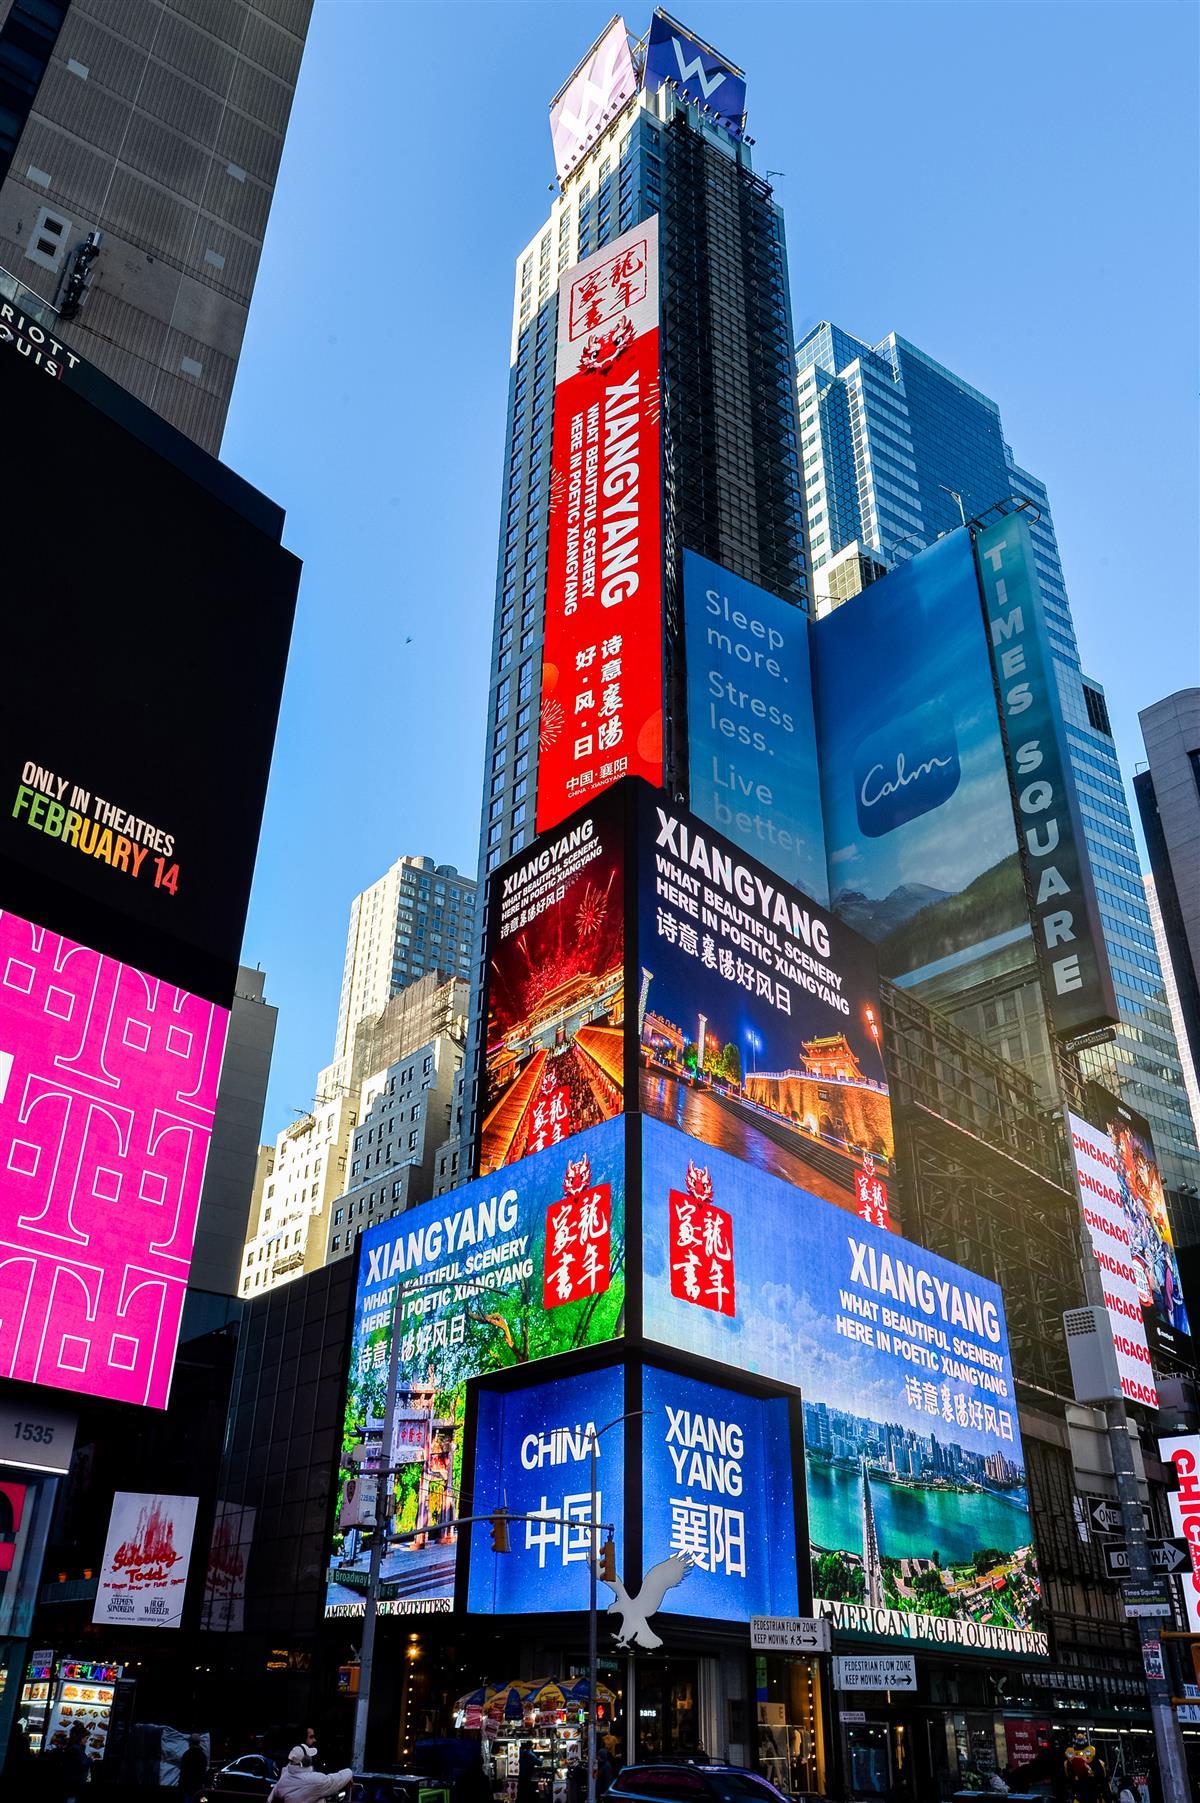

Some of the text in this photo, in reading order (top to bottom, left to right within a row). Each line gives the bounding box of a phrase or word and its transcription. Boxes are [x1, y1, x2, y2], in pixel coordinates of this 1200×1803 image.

[671, 37, 727, 100] W
[1, 304, 80, 368] RIOTT
[564, 411, 583, 616] HERE IN POETIC XIANGYANG
[581, 402, 600, 599] WHAT BEAUTIFUL SCENERY
[600, 369, 640, 608] XIANGYANG
[705, 590, 784, 650] Sleep
[707, 626, 789, 683] more.
[708, 671, 794, 733] Stress
[711, 703, 774, 756] less.
[567, 787, 587, 798] CHINA
[712, 756, 773, 806] Live
[861, 753, 952, 807] Calm
[984, 540, 1083, 997] TIMES SQUARE
[21, 761, 175, 857] ONLY IN THEATRES
[714, 791, 813, 862] better.
[12, 785, 180, 896] FEBRUARY 14
[502, 819, 594, 899] XIANGYANG
[501, 845, 603, 921] HERE IN POETIC XIANGYANG
[502, 836, 599, 911] WHAT BEAUTIFUL SCENERY
[656, 806, 831, 958] XIANGYANG
[656, 853, 842, 991] WHAT BEAUTIFUL SCENERY
[656, 877, 850, 1016] HERE IN POETIC XIANGYANG
[1072, 1132, 1118, 1172] CHICAGO
[1078, 1169, 1123, 1209] CHICAGO
[365, 1189, 519, 1287] XIANGYANG
[1084, 1207, 1130, 1246] CHICAGO
[361, 1309, 391, 1335] HERE
[407, 1288, 452, 1318] POETIC
[453, 1258, 534, 1302] XIANGYANG
[363, 1286, 396, 1313] WHAT
[465, 1235, 529, 1275] SCENERY
[847, 1236, 1001, 1343] XIANGYANG
[839, 1289, 1004, 1373] WHAT BEAUTIFUL SCENERY
[1104, 1291, 1144, 1325] HICAGO
[836, 1314, 1008, 1397] HERE IN POETIC XIANGYANG
[1113, 1334, 1151, 1366] HICAGO
[1120, 1376, 1159, 1407] HICAGO
[13, 1421, 54, 1445] 1535
[521, 1421, 601, 1470] CHINA
[664, 1404, 744, 1460] XIANG
[668, 1445, 743, 1496] YANG
[525, 1491, 602, 1568] 中国
[669, 1496, 747, 1578] 襄阳
[1099, 1509, 1117, 1524] ONE
[112, 1542, 184, 1572] Sweeney
[125, 1565, 169, 1583] Todd
[335, 1572, 368, 1587] Broadway
[1151, 1550, 1177, 1564] WAY
[326, 1604, 367, 1618] AMERICAN
[397, 1598, 451, 1615] OUTFITTERS
[1140, 1589, 1160, 1597] Square
[753, 1620, 817, 1633] PEDESTRIAN FLOW ZONE
[754, 1634, 788, 1645] KEEP MOVING
[818, 1601, 912, 1639] AMERICAN
[916, 1615, 964, 1644] EAGLE
[844, 1660, 911, 1672] PEDESTRIAN FLOW ZONE
[845, 1674, 882, 1685] KEEP MOVING
[639, 1709, 657, 1717] eans
